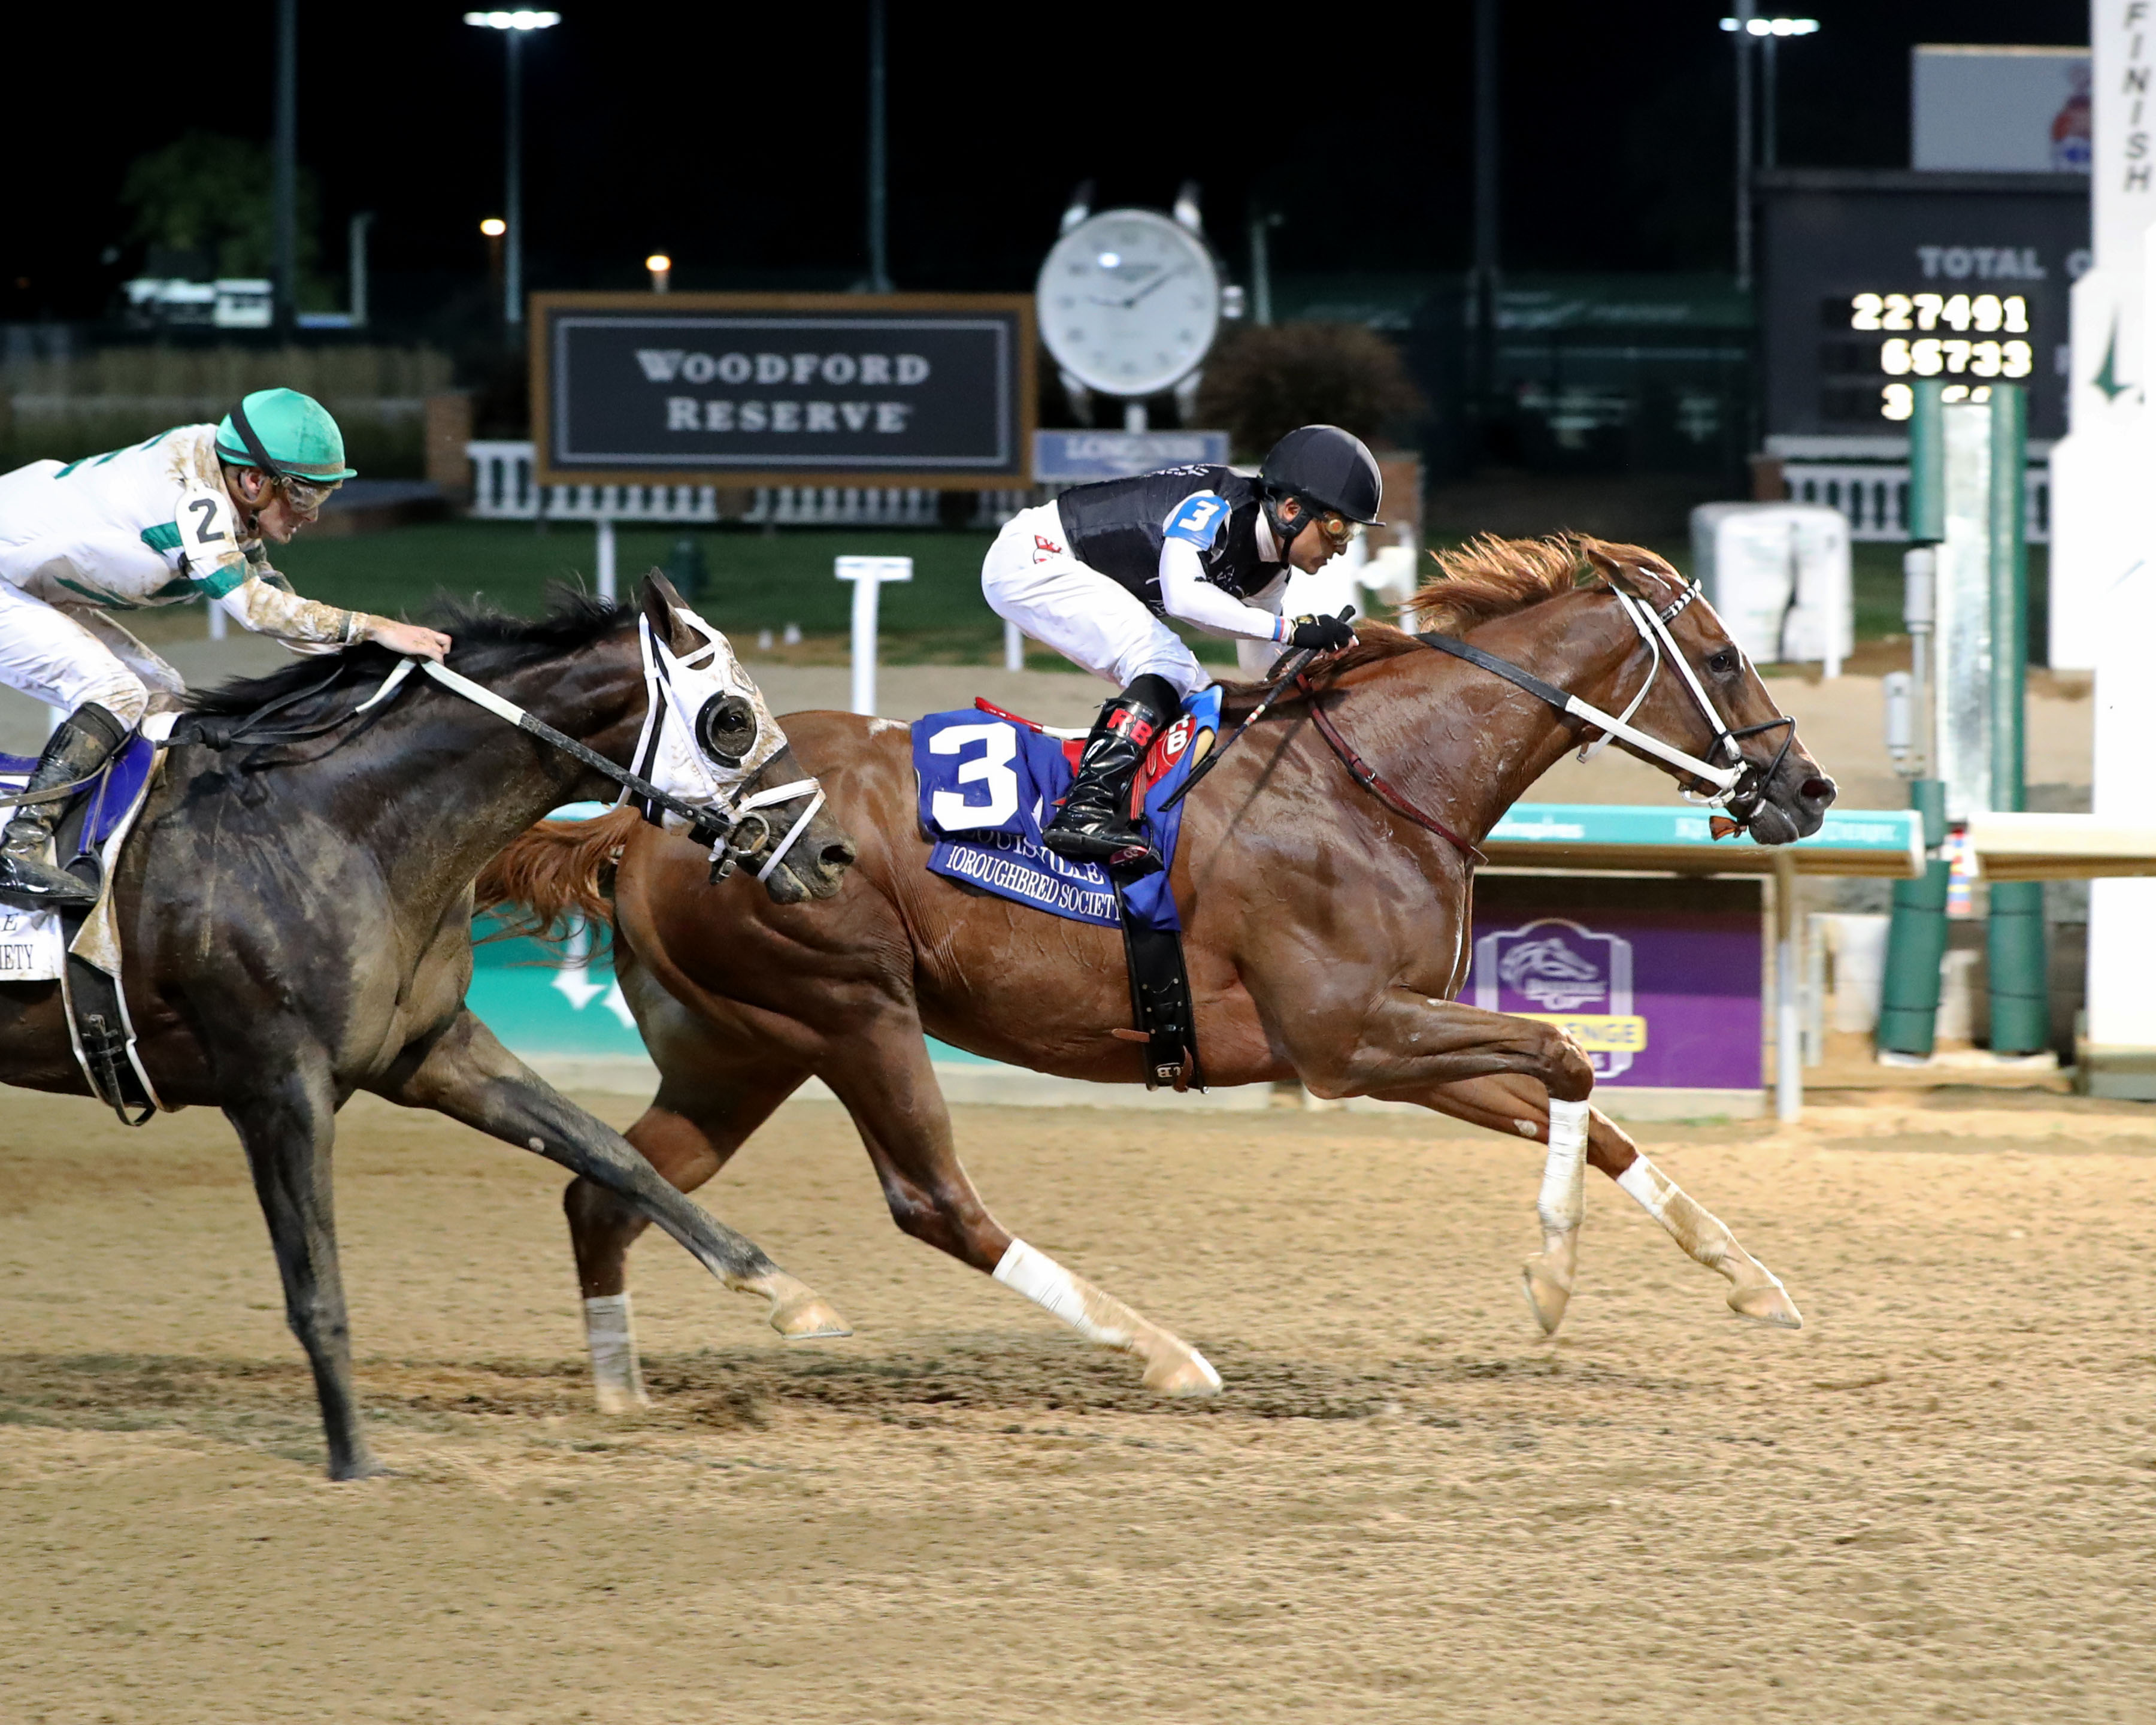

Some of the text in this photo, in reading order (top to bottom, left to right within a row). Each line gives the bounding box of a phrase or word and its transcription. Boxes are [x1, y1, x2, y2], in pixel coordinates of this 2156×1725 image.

[2122, 2, 2151, 192] FINISH
[1918, 246, 2047, 279] TOTAL
[1852, 293, 2028, 333] 227491
[635, 349, 931, 385] WOODFORD
[665, 397, 909, 433] RESERVE
[188, 498, 225, 544] 2
[1178, 500, 1221, 532] 3
[1107, 707, 1153, 746] RB
[929, 722, 1018, 831] 3
